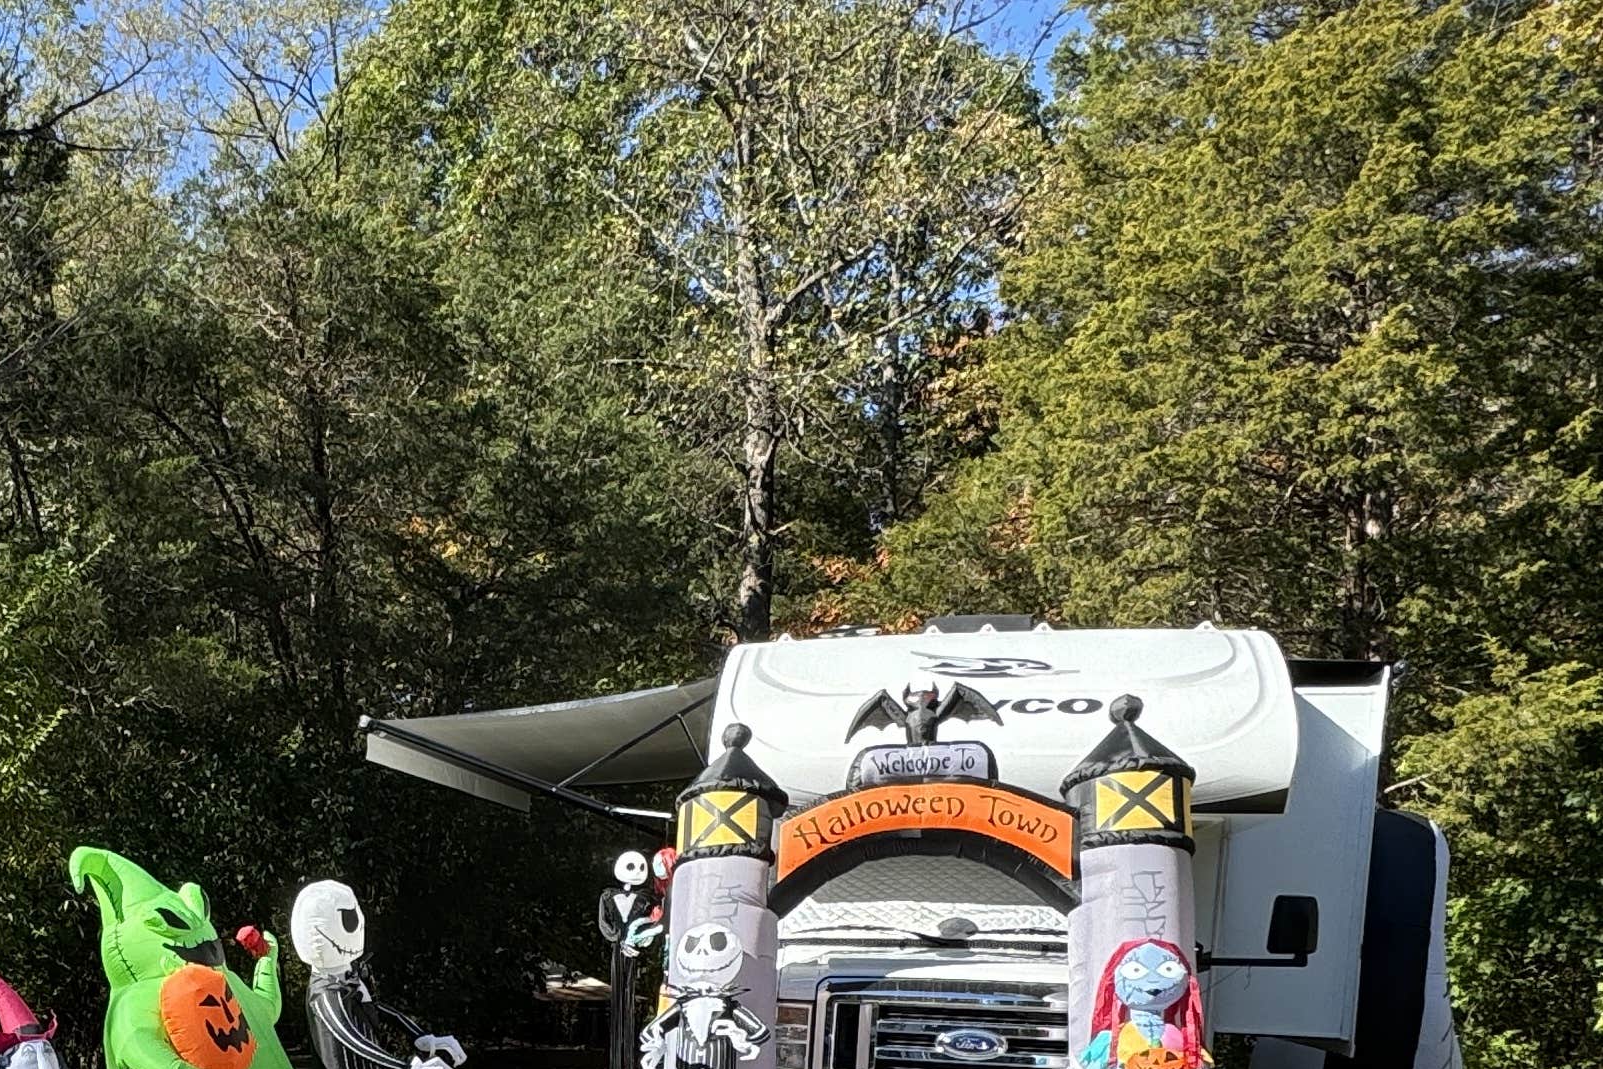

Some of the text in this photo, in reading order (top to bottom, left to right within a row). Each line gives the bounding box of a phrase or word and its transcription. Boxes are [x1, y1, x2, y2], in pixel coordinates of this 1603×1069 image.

[871, 747, 976, 776] Welcome To
[792, 794, 1060, 851] Halloween Town
[955, 1037, 990, 1051] Ford
